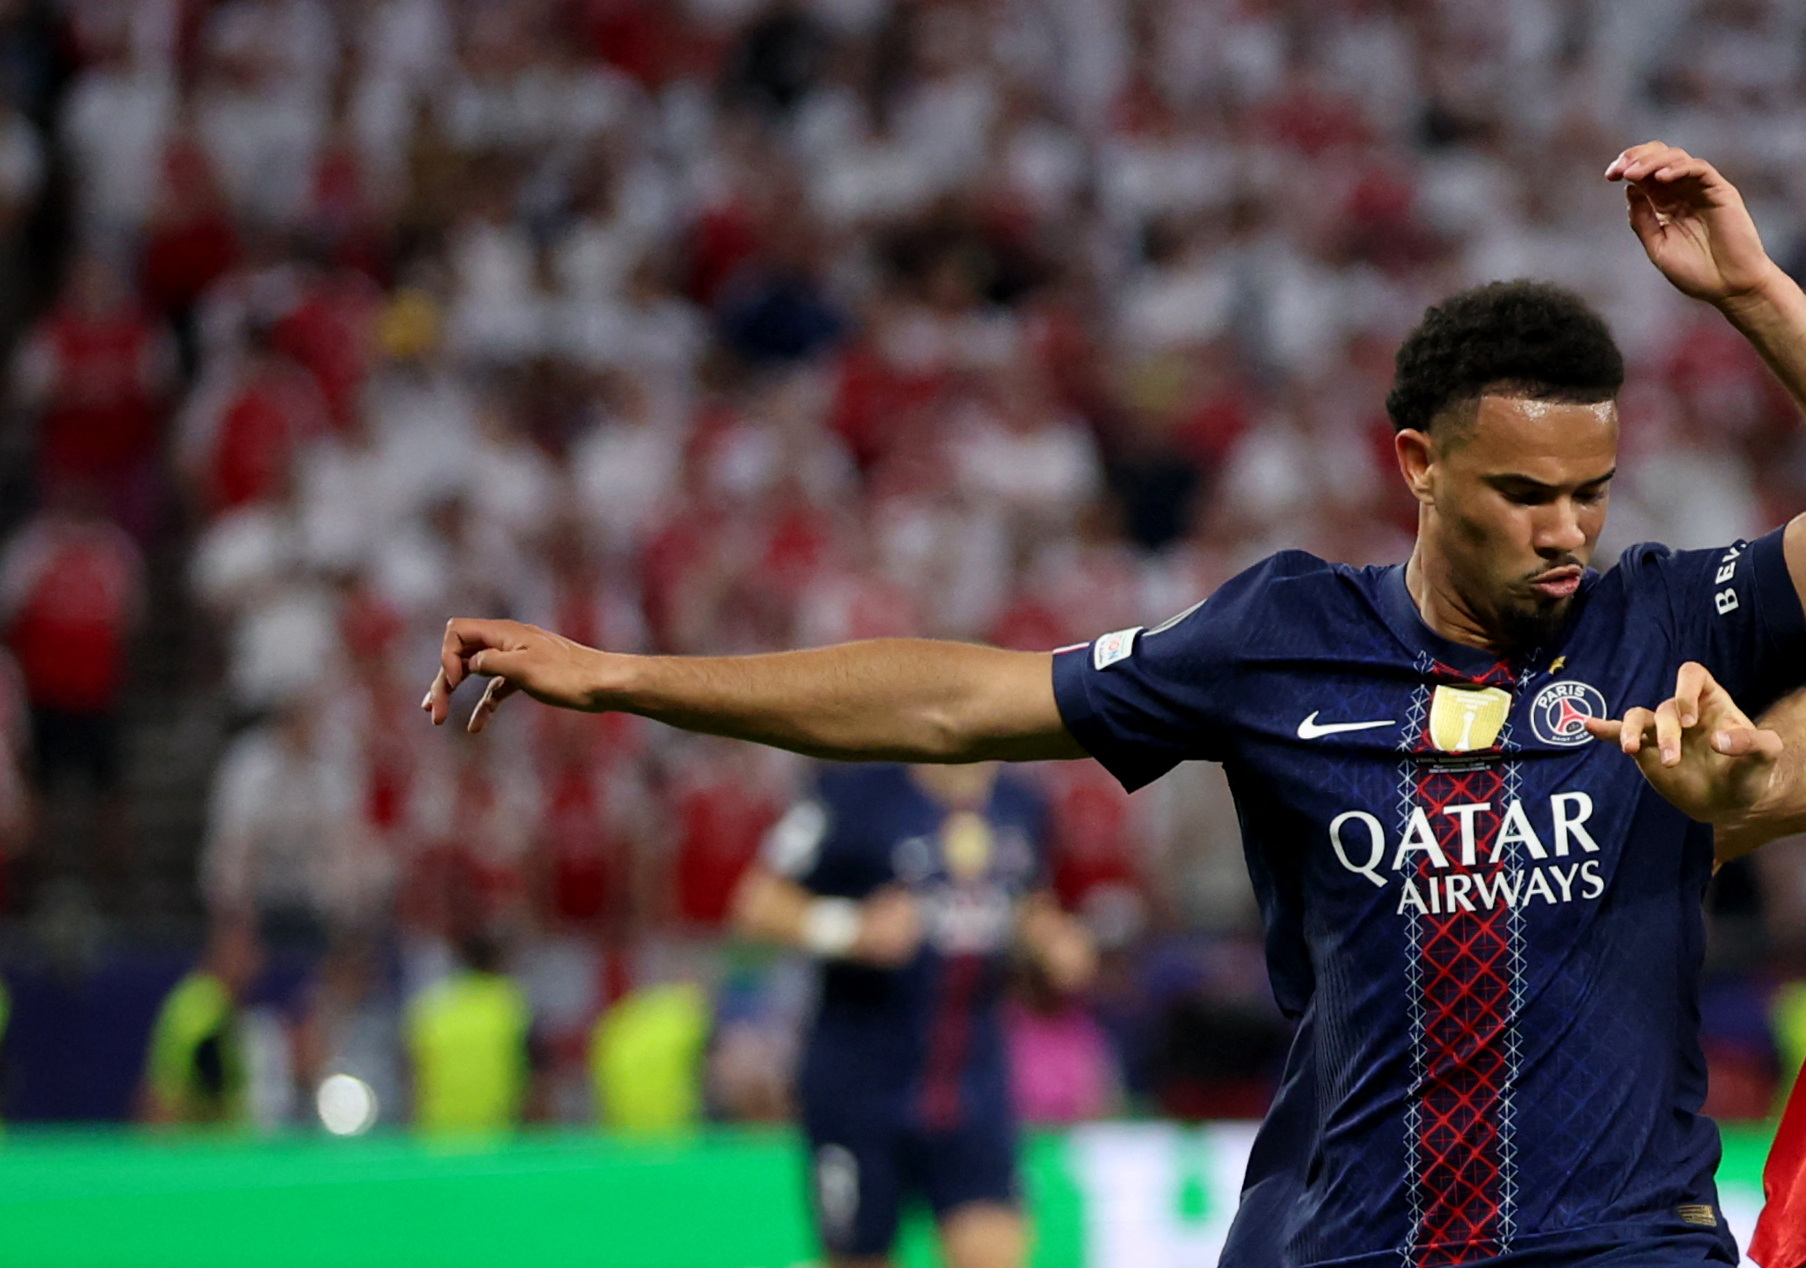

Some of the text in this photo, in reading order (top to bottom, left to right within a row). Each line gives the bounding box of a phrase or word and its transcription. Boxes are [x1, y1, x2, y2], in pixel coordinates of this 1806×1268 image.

[1538, 685, 1586, 709] PARIS
[1329, 791, 1600, 888] QATAR
[1396, 860, 1605, 916] AIRWAYS
